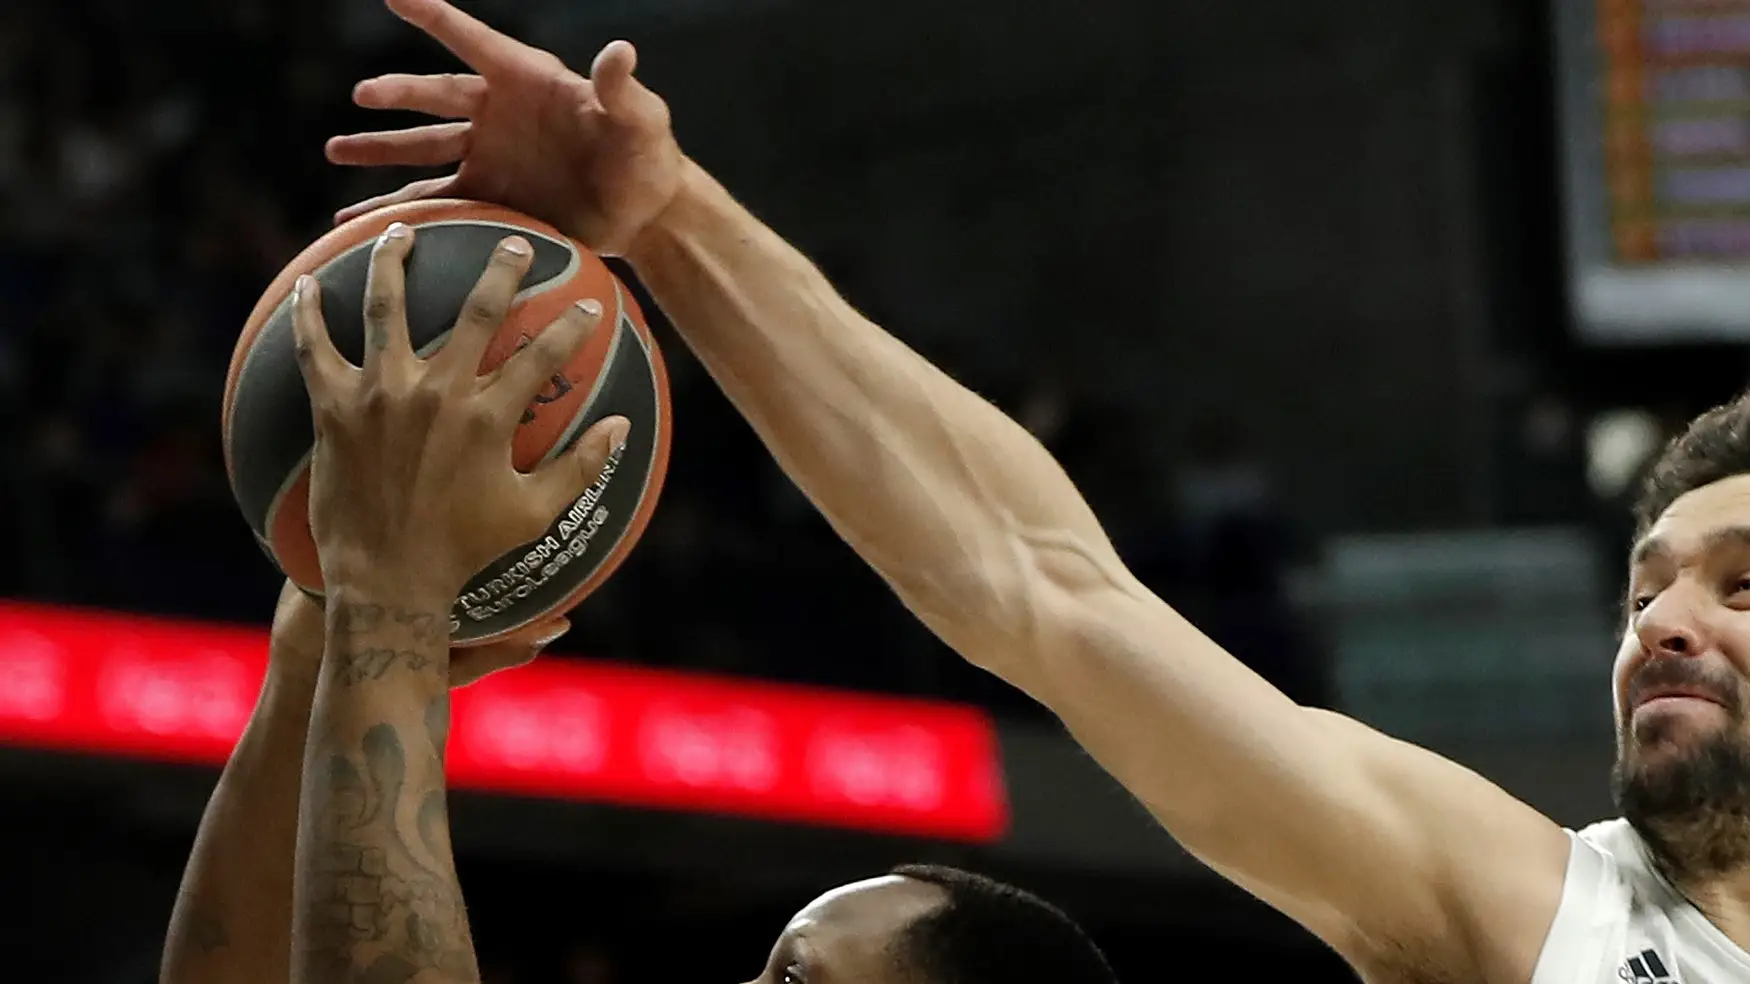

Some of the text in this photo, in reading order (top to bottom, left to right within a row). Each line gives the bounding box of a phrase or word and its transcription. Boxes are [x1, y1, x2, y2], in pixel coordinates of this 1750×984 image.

[456, 443, 626, 610] TURKISH AIRLIN
[466, 504, 610, 621] EuroLeague
